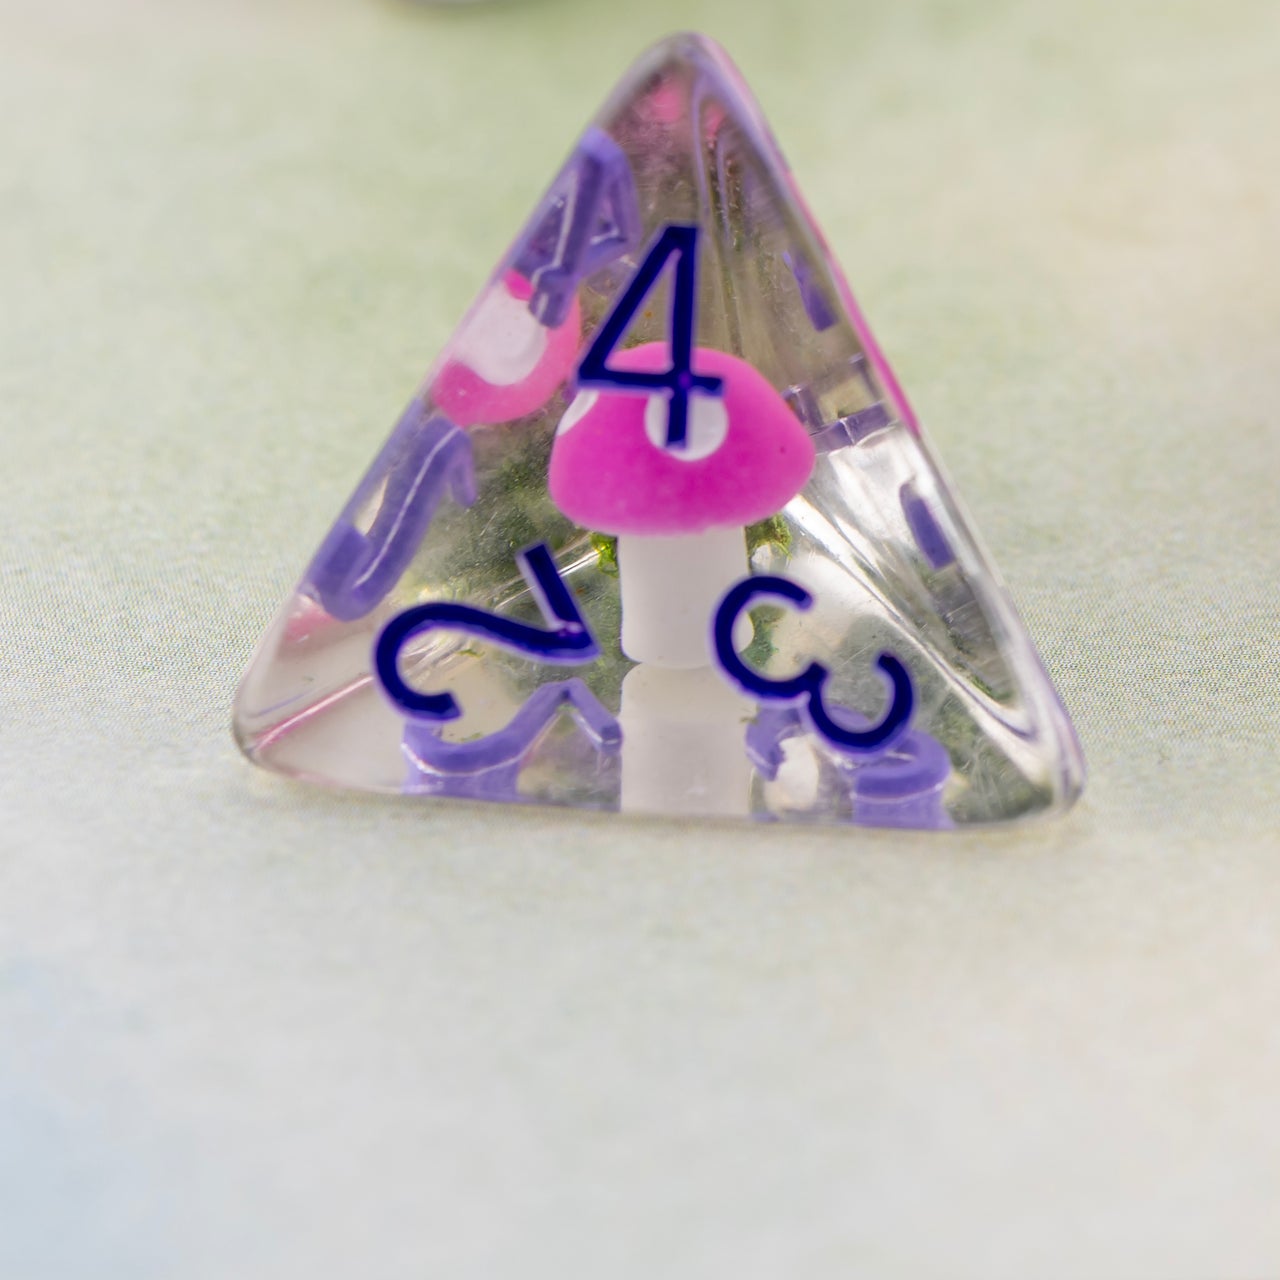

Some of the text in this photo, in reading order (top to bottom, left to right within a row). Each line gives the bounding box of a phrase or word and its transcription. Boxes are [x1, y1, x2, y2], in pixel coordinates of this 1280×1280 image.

[575, 223, 725, 449] 4
[373, 542, 601, 719] 2
[711, 572, 917, 754] 3
